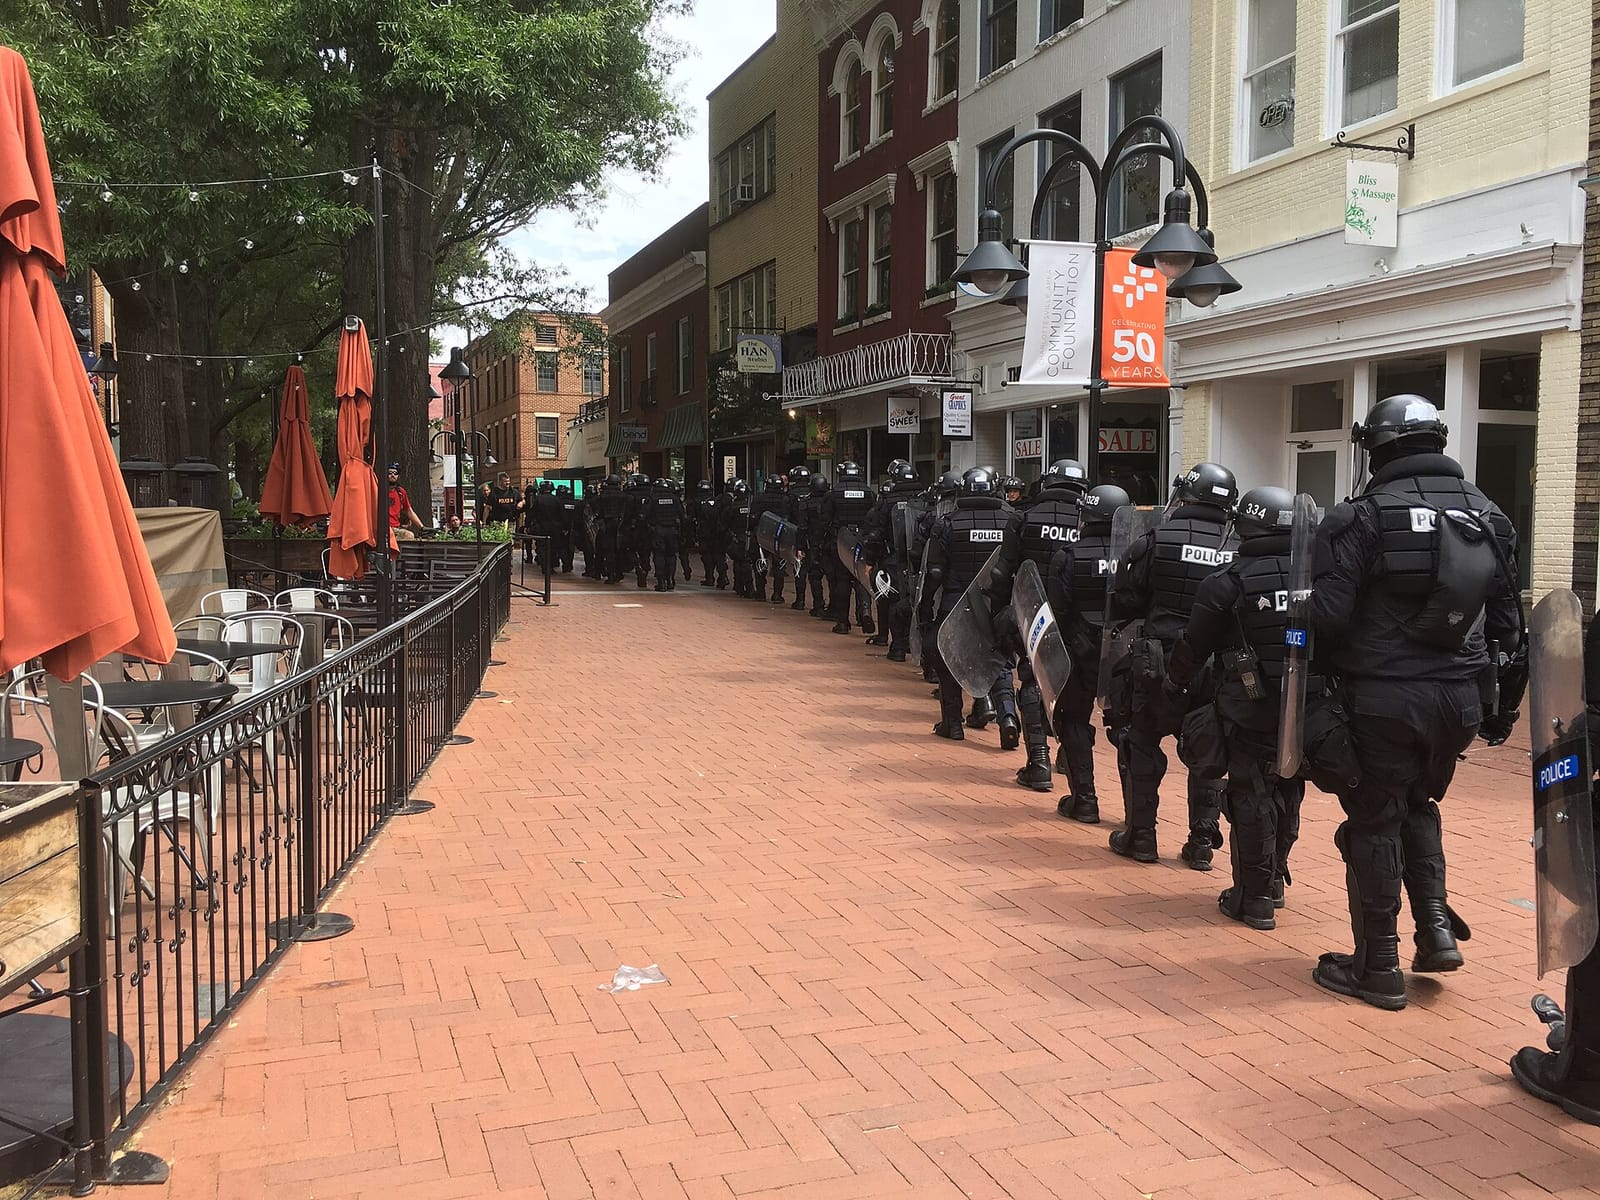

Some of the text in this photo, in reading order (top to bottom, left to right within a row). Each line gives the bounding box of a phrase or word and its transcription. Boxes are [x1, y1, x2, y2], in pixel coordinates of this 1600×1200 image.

[1260, 101, 1294, 126] OPEN
[1358, 174, 1377, 186] Bliss
[1360, 188, 1396, 203] Massage
[1061, 253, 1079, 370] FOUNDATION
[1046, 270, 1065, 377] COMMUNITY
[1111, 319, 1157, 330] CELEBRATING
[741, 347, 768, 356] HAN
[1111, 329, 1155, 363] 50
[1110, 366, 1162, 379] YEARS
[889, 415, 919, 427] SWEET
[1015, 440, 1041, 458] SALE
[1098, 430, 1155, 452] SALE
[1245, 503, 1267, 520] 334
[971, 530, 1002, 541] POLICE
[1184, 547, 1230, 564] POLICE
[1285, 630, 1303, 646] POLICE
[1540, 758, 1573, 788] POLICE
